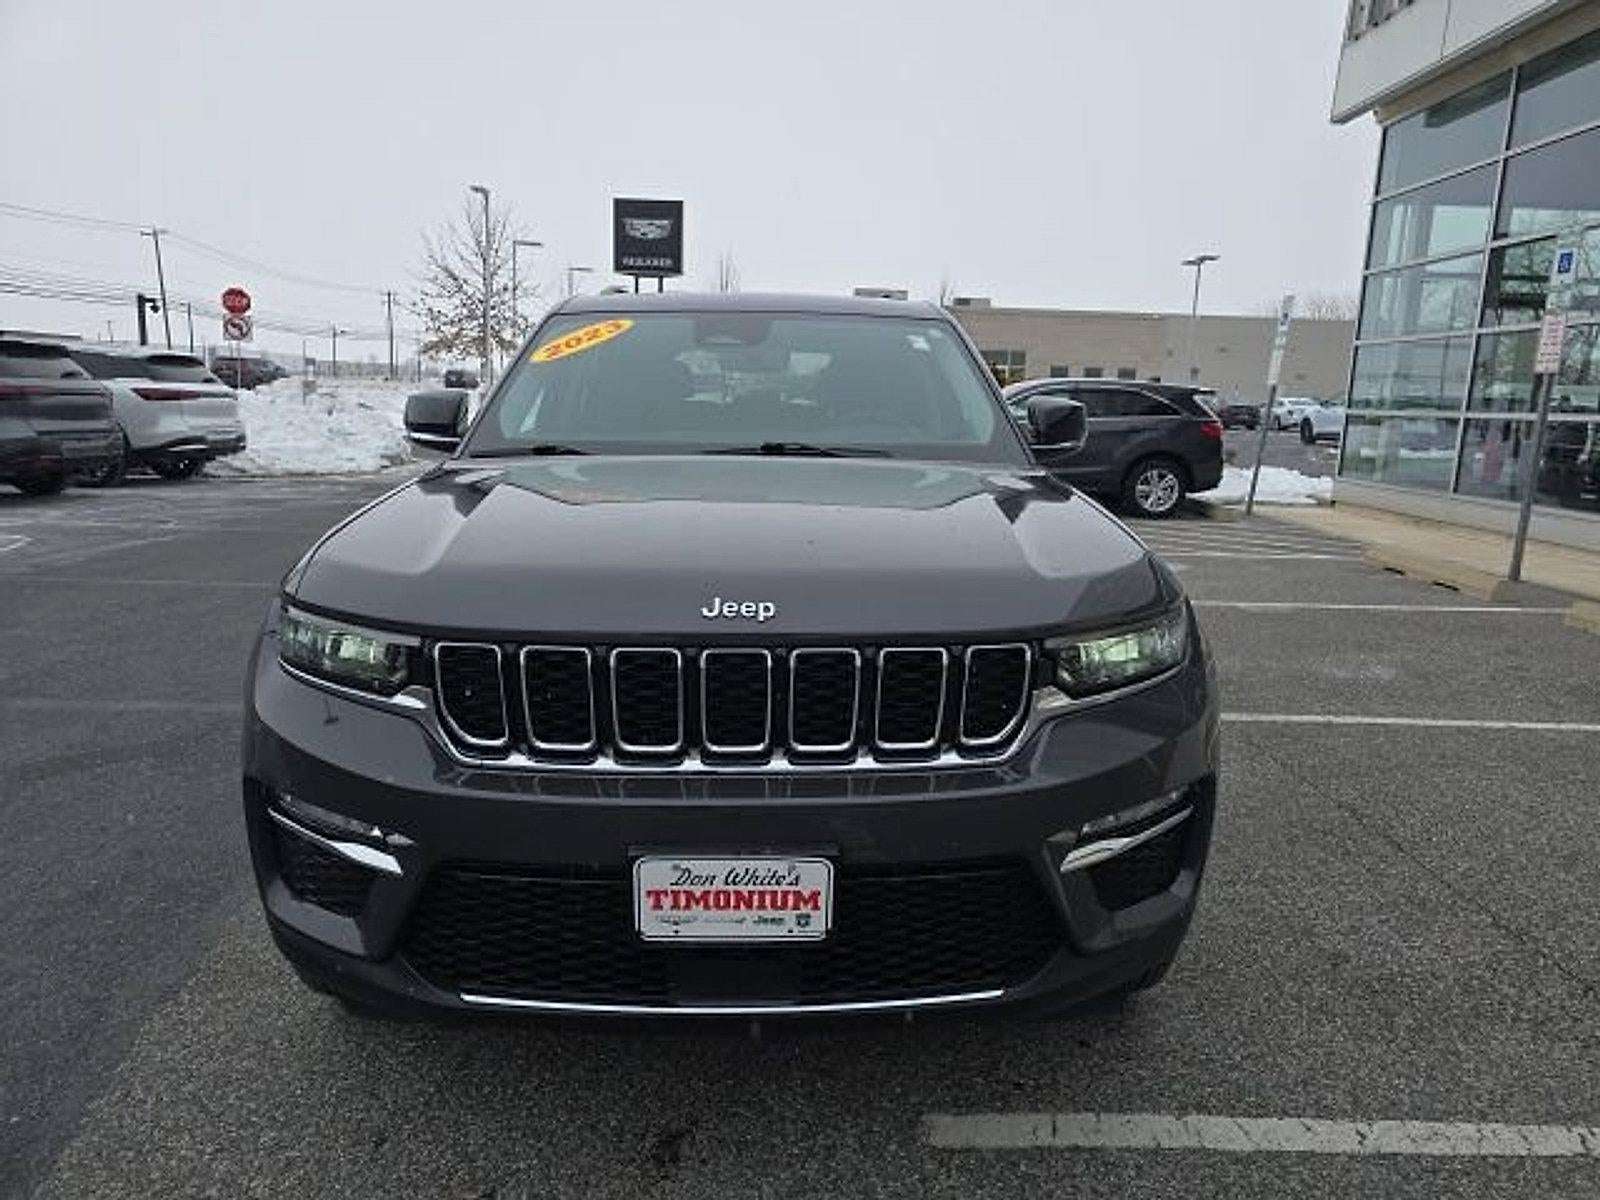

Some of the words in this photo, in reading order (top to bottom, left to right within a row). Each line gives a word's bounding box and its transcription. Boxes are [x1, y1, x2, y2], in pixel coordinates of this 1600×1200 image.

[542, 321, 622, 359] 2023
[701, 597, 775, 621] Jeep
[670, 867, 716, 886] Don
[725, 867, 800, 886] White's
[646, 890, 821, 911] TIMONIUM
